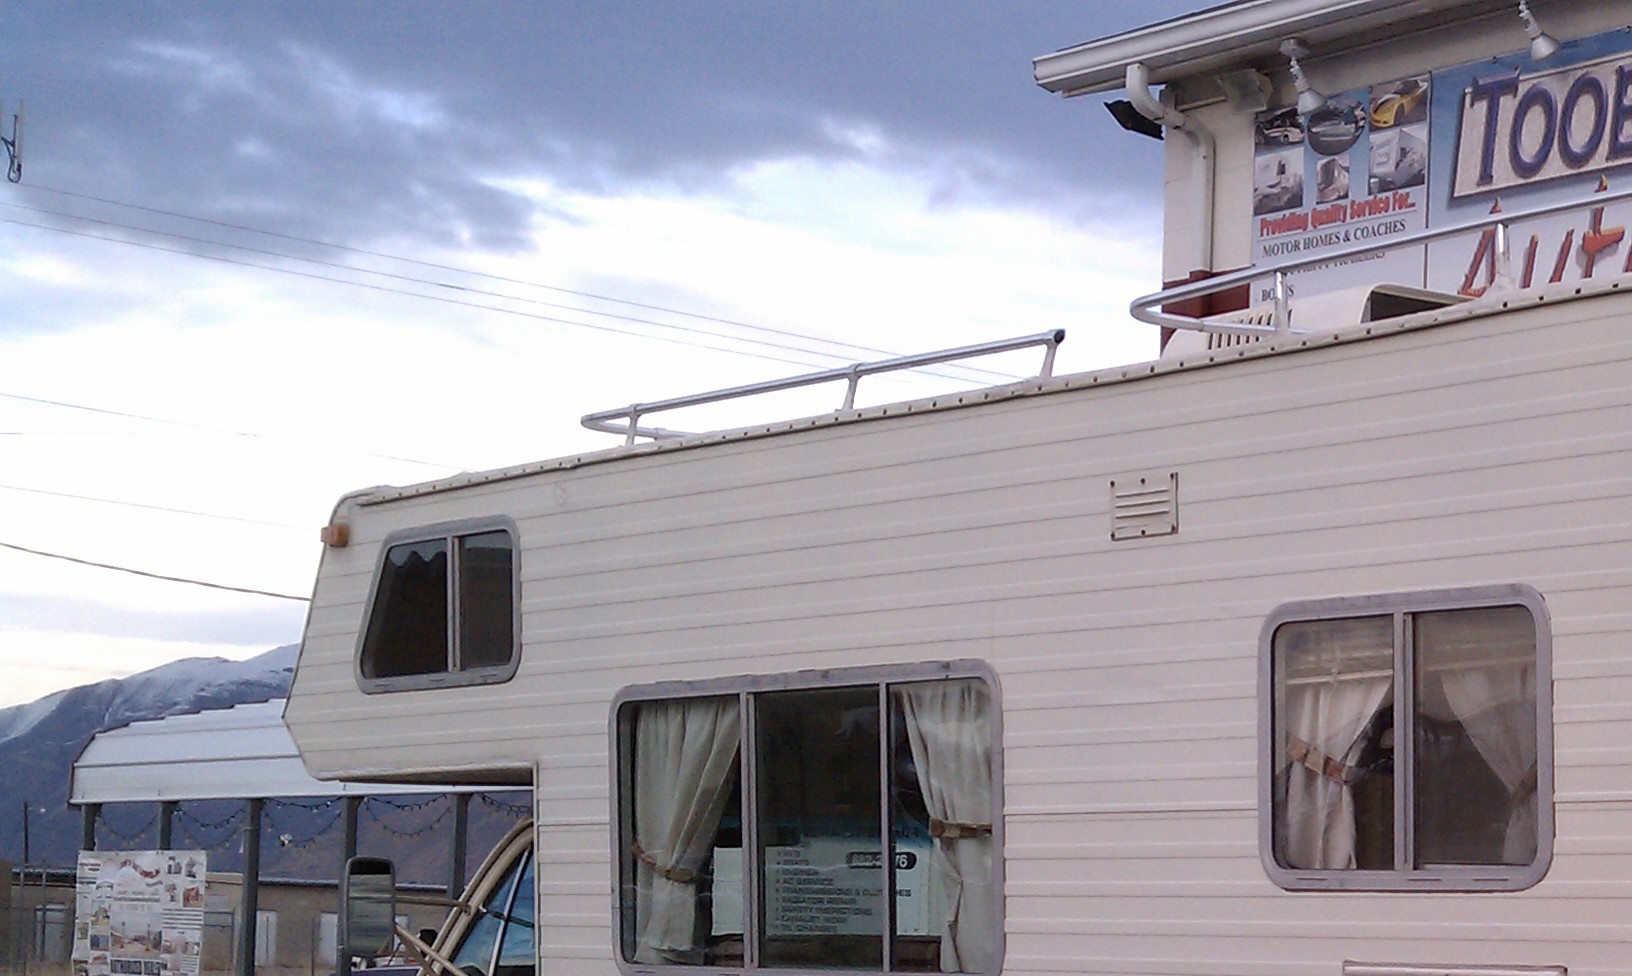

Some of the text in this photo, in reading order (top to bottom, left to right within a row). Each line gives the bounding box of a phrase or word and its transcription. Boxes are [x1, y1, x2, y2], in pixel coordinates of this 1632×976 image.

[1259, 212, 1309, 238] Providing
[1311, 202, 1348, 229] Quality
[1350, 194, 1391, 220] Service
[1261, 218, 1407, 259] MOTOR HOMES & COACHES
[1261, 284, 1294, 303] BOS
